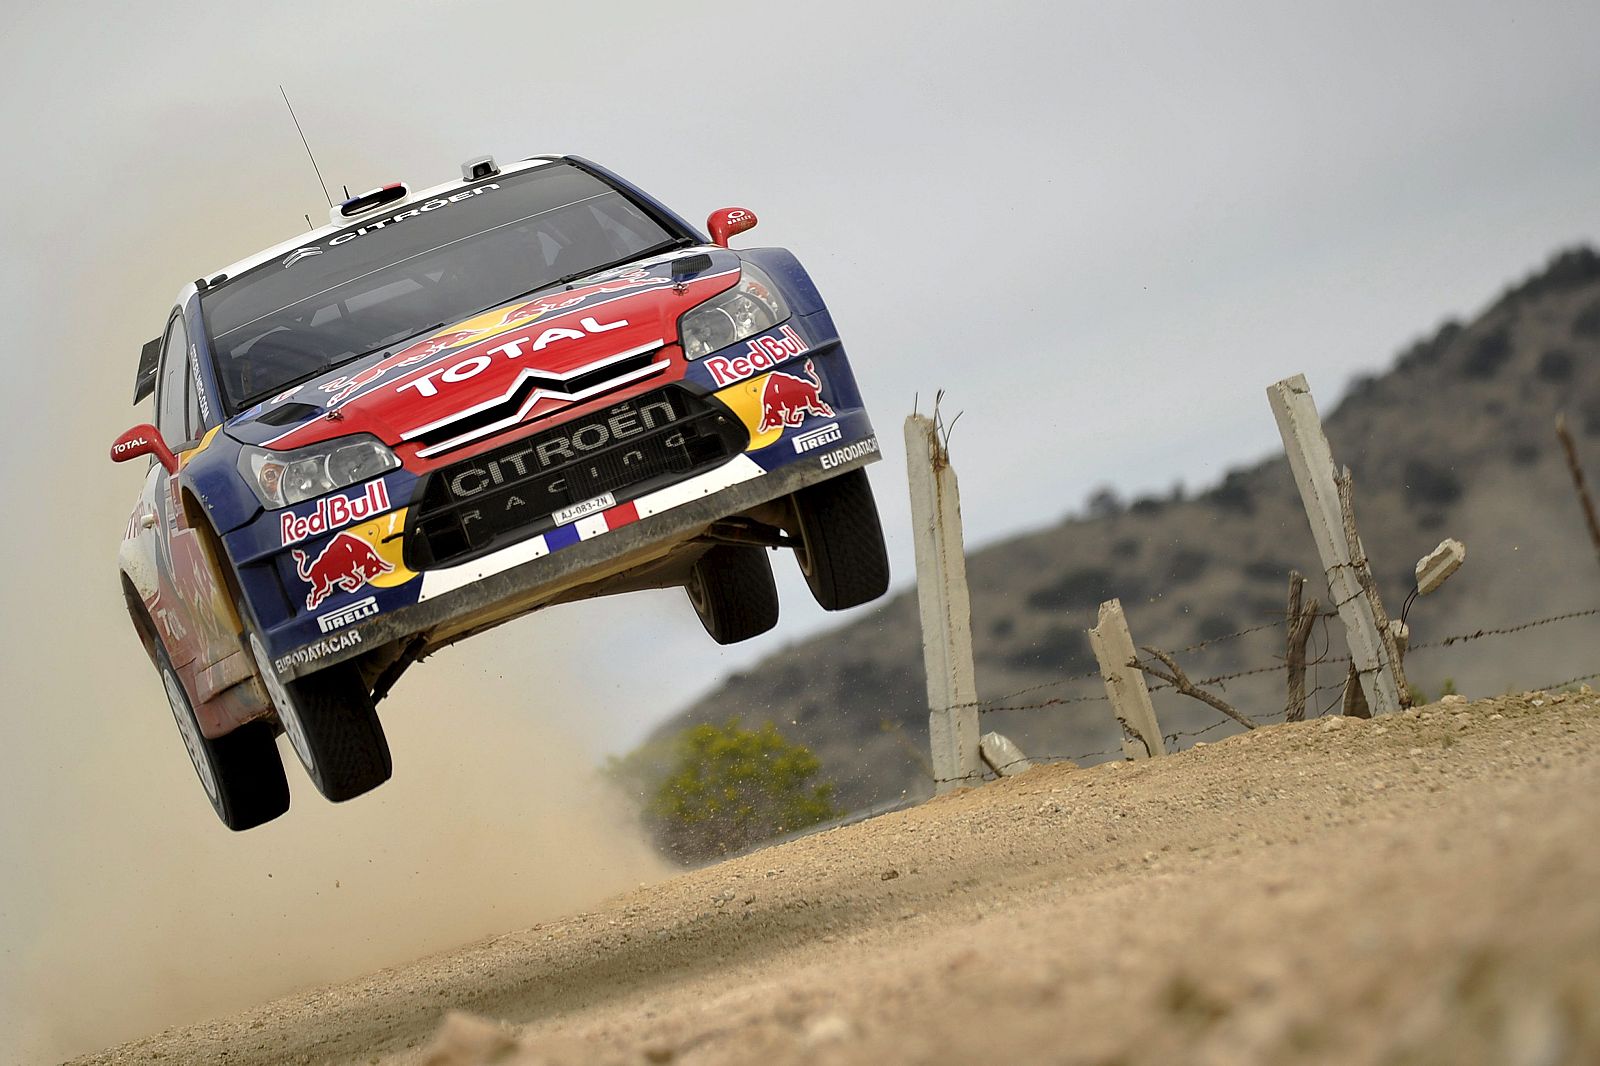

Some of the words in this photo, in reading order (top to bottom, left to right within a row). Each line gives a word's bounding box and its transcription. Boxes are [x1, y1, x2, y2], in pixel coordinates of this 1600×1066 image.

[396, 317, 629, 397] TOTAL
[704, 340, 773, 387] Red
[758, 325, 808, 363] Bull
[113, 437, 148, 454] TOTAL
[791, 422, 842, 454] PIRELLI
[281, 498, 328, 547] Red
[327, 478, 391, 529] Bull
[562, 496, 608, 520] AJ-083-ZN
[316, 596, 380, 633] PIRELLI
[274, 629, 362, 674] EURODATACAR
